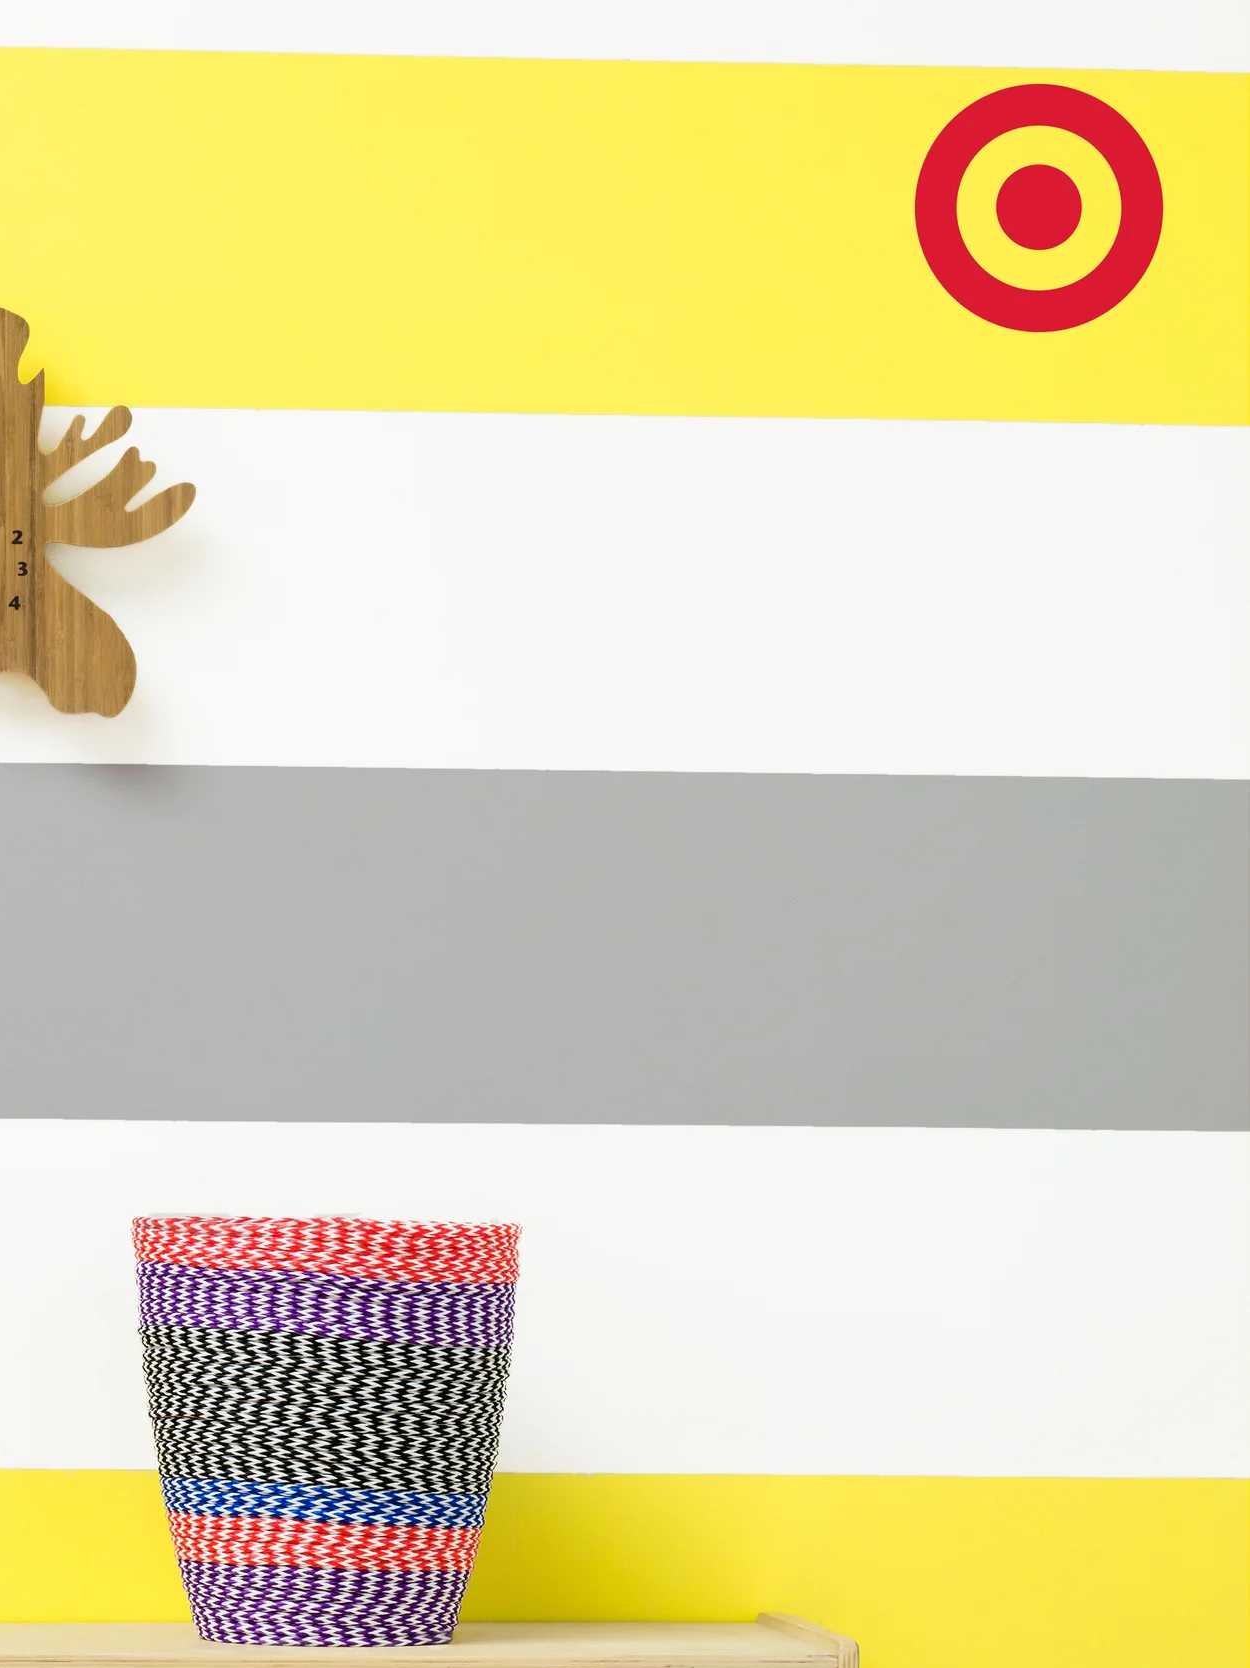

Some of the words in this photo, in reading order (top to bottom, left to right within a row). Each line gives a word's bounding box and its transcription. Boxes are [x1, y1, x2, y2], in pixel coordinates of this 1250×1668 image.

[11, 530, 23, 545] 2
[17, 561, 28, 576] 3
[8, 596, 21, 611] 4
